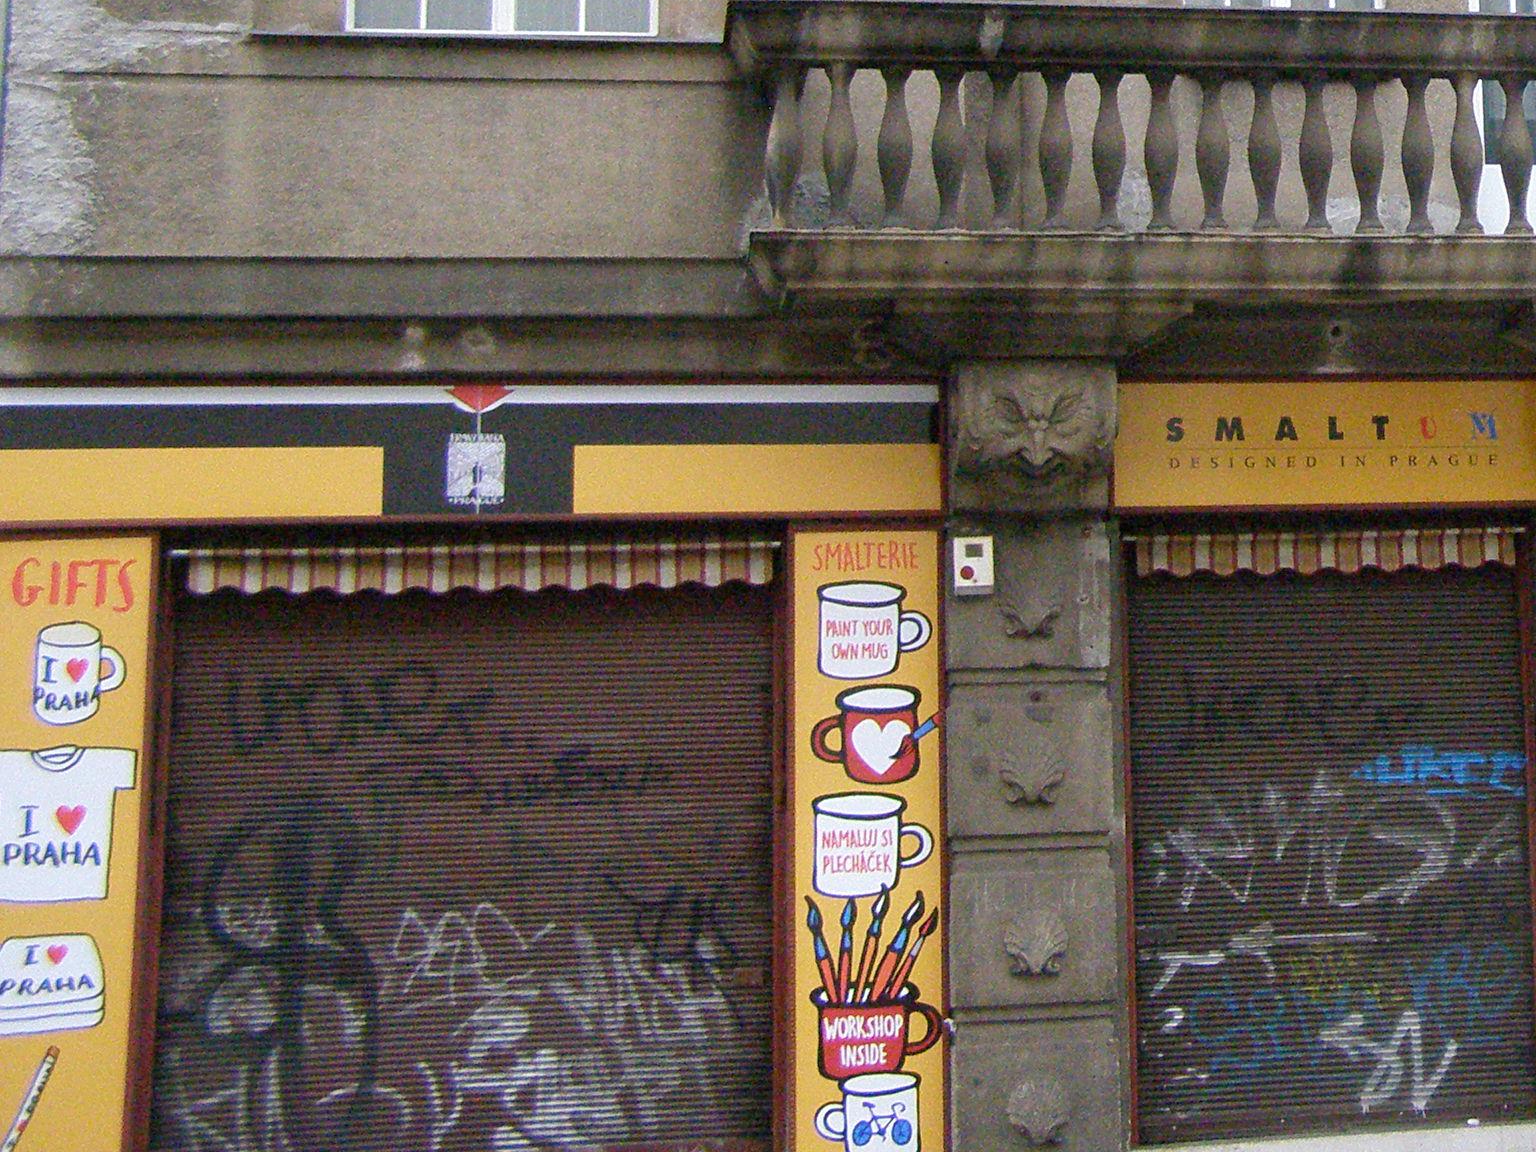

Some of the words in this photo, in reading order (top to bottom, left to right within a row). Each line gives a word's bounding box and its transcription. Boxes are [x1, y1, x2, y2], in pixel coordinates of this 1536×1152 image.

[1166, 409, 1498, 442] SMALTUM
[1169, 455, 1317, 469] DESIGNED
[1341, 455, 1366, 467] IN
[1390, 453, 1499, 468] PRAGUE
[812, 541, 919, 572] SMALTERIE
[12, 557, 137, 612] GIFTS
[826, 620, 858, 637] PAINT
[863, 619, 894, 636] YOUR
[832, 644, 859, 660] OWN
[862, 644, 888, 659] MUG
[42, 656, 58, 683] I
[34, 684, 100, 711] PRAHA
[19, 805, 39, 837] I
[822, 829, 878, 848] NAMALUJ
[882, 829, 893, 847] SI
[3, 840, 101, 867] PRAHA
[823, 851, 892, 874] PLECHÁČEK
[25, 944, 40, 965] I
[0, 974, 94, 996] PRAHA
[823, 1014, 904, 1041] WORKSHOP
[840, 1043, 888, 1067] INSIDE
